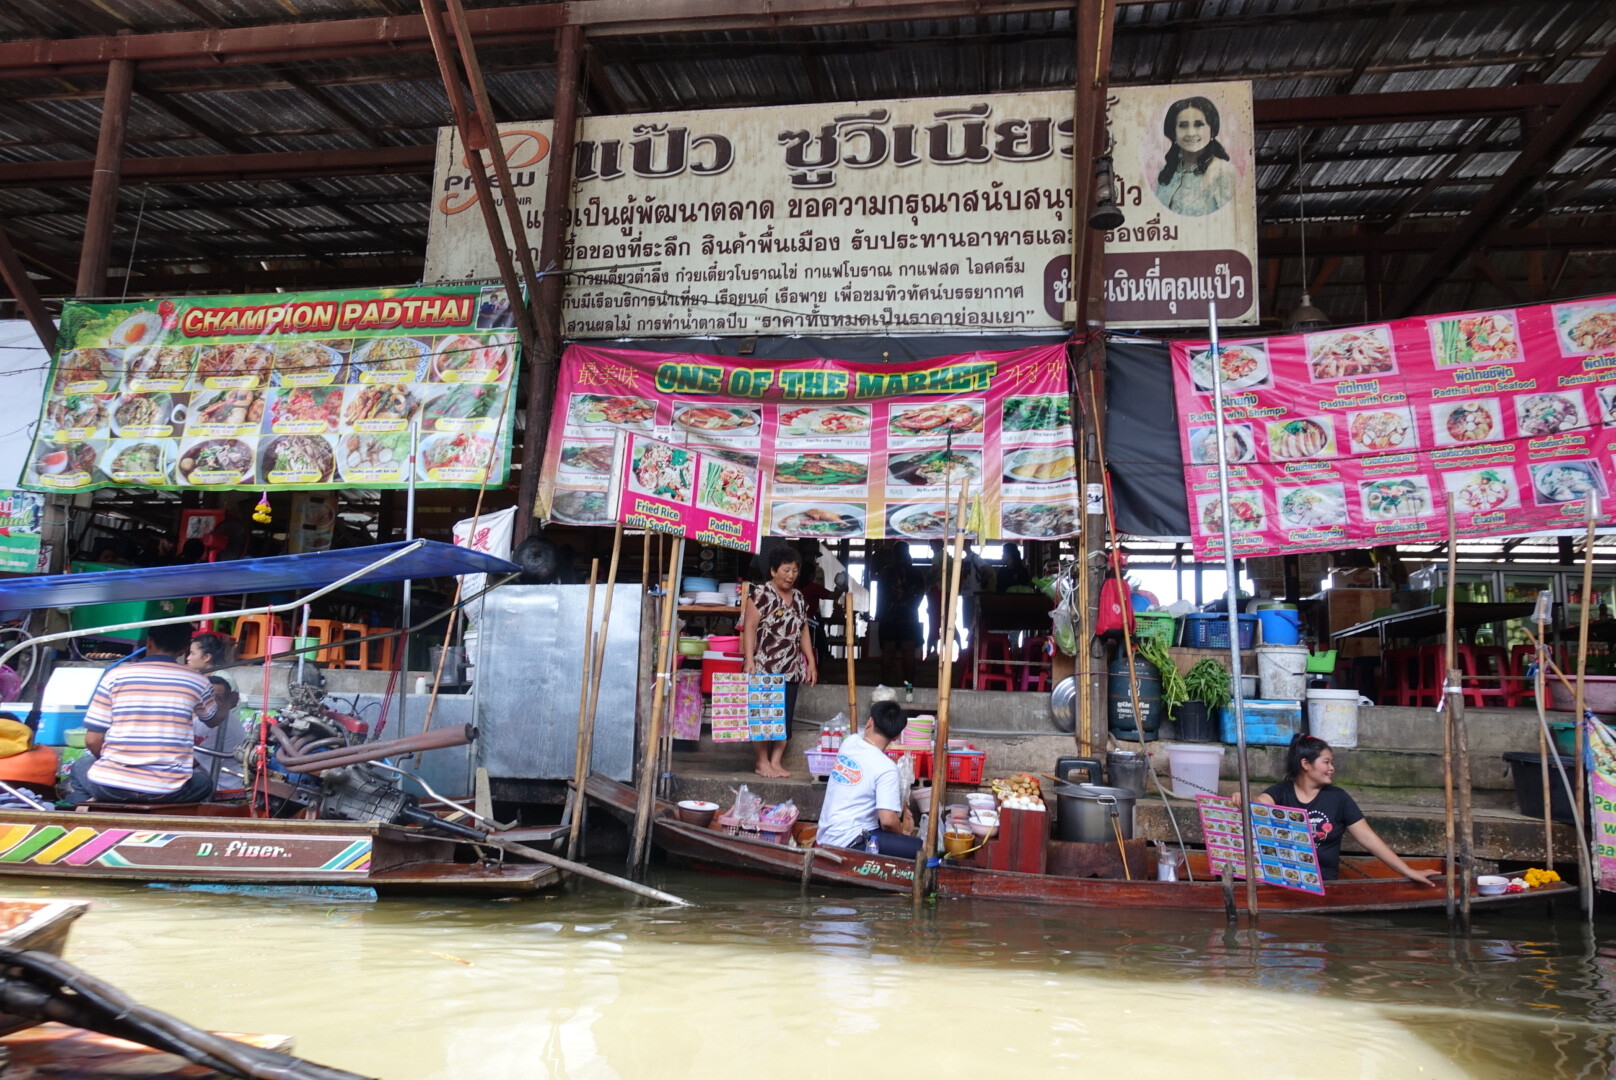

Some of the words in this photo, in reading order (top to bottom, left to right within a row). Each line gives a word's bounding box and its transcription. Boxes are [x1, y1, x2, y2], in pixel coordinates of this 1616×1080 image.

[701, 224, 841, 256] สินค้าพื้นเมือง
[804, 259, 893, 280] กาแฟโบราณ
[899, 260, 960, 278] กาแฟสด
[775, 285, 828, 305] เรือพาย
[834, 280, 1025, 303] เพื่อชมทิวทัศน์บรรยากาศ
[184, 303, 333, 333] CHAMPION
[341, 299, 471, 328] PADTHAI
[566, 313, 632, 333] สวนผลไม้
[577, 361, 640, 389] 最美味
[655, 361, 724, 394] ONE
[728, 368, 774, 398] OF
[778, 368, 849, 400] THE
[854, 360, 998, 400] MARKET
[1047, 359, 1068, 383] 맛
[1432, 387, 1470, 397] Padthai
[1473, 384, 1494, 394] with
[1497, 379, 1535, 391] Seafood
[1320, 398, 1356, 409] Padthai
[1358, 396, 1379, 406] with
[1382, 393, 1405, 403] Crab
[1189, 411, 1218, 422] Padth
[636, 500, 660, 515] Fried
[660, 504, 680, 520] Rice
[626, 515, 648, 528] with
[648, 518, 686, 537] Seafood
[709, 518, 743, 535] Padthai
[696, 531, 716, 544] with
[717, 535, 751, 552] Seafood
